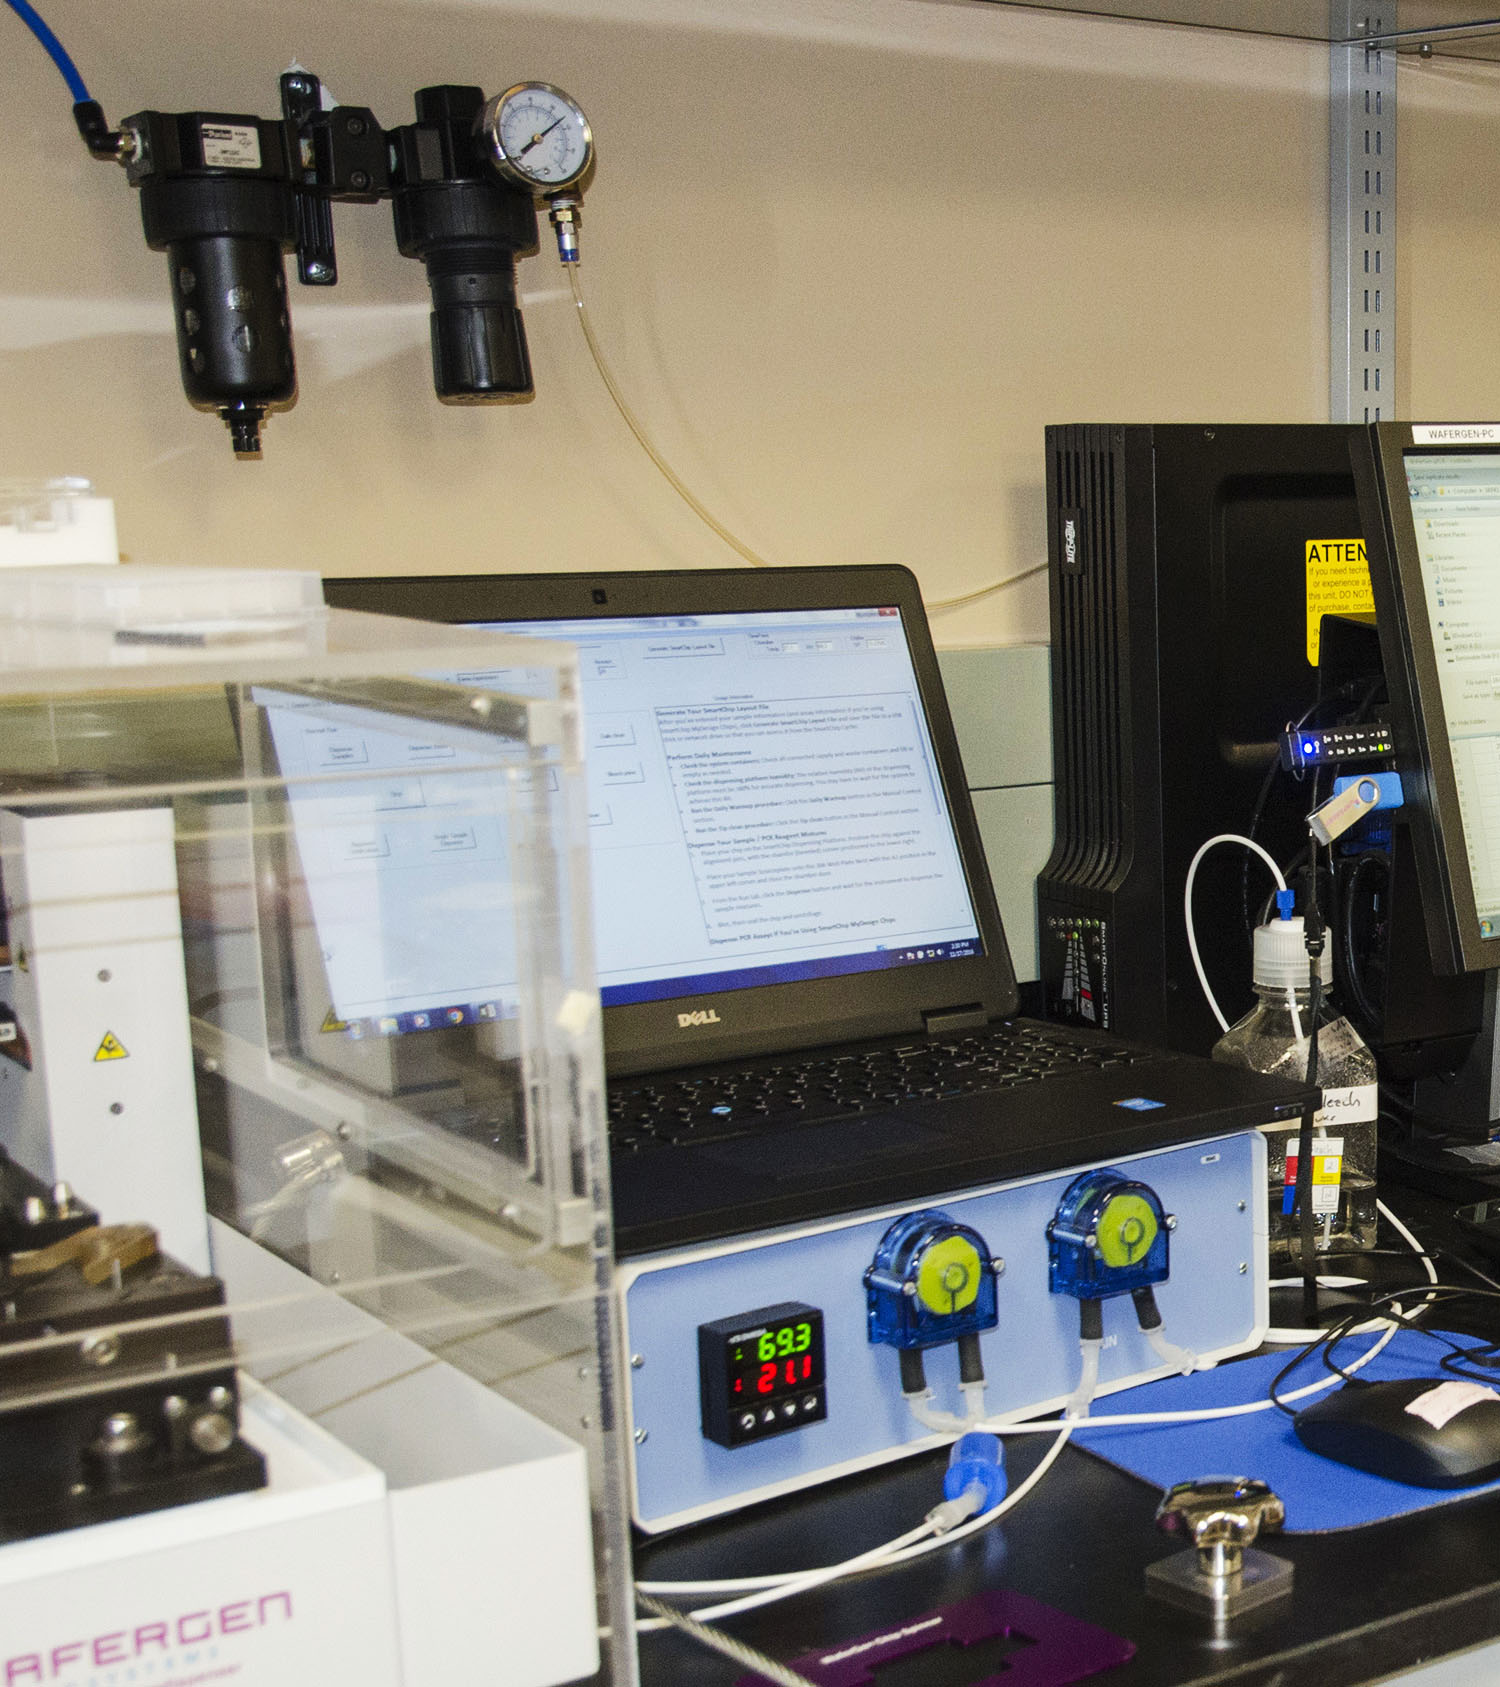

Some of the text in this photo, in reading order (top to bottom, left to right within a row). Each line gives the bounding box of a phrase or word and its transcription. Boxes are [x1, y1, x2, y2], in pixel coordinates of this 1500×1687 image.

[1428, 429, 1495, 439] WAFERGEN-PC
[1308, 543, 1368, 563] ATTEN
[1340, 590, 1352, 599] DO
[1353, 588, 1370, 598] NOT
[677, 1008, 721, 1028] DELL
